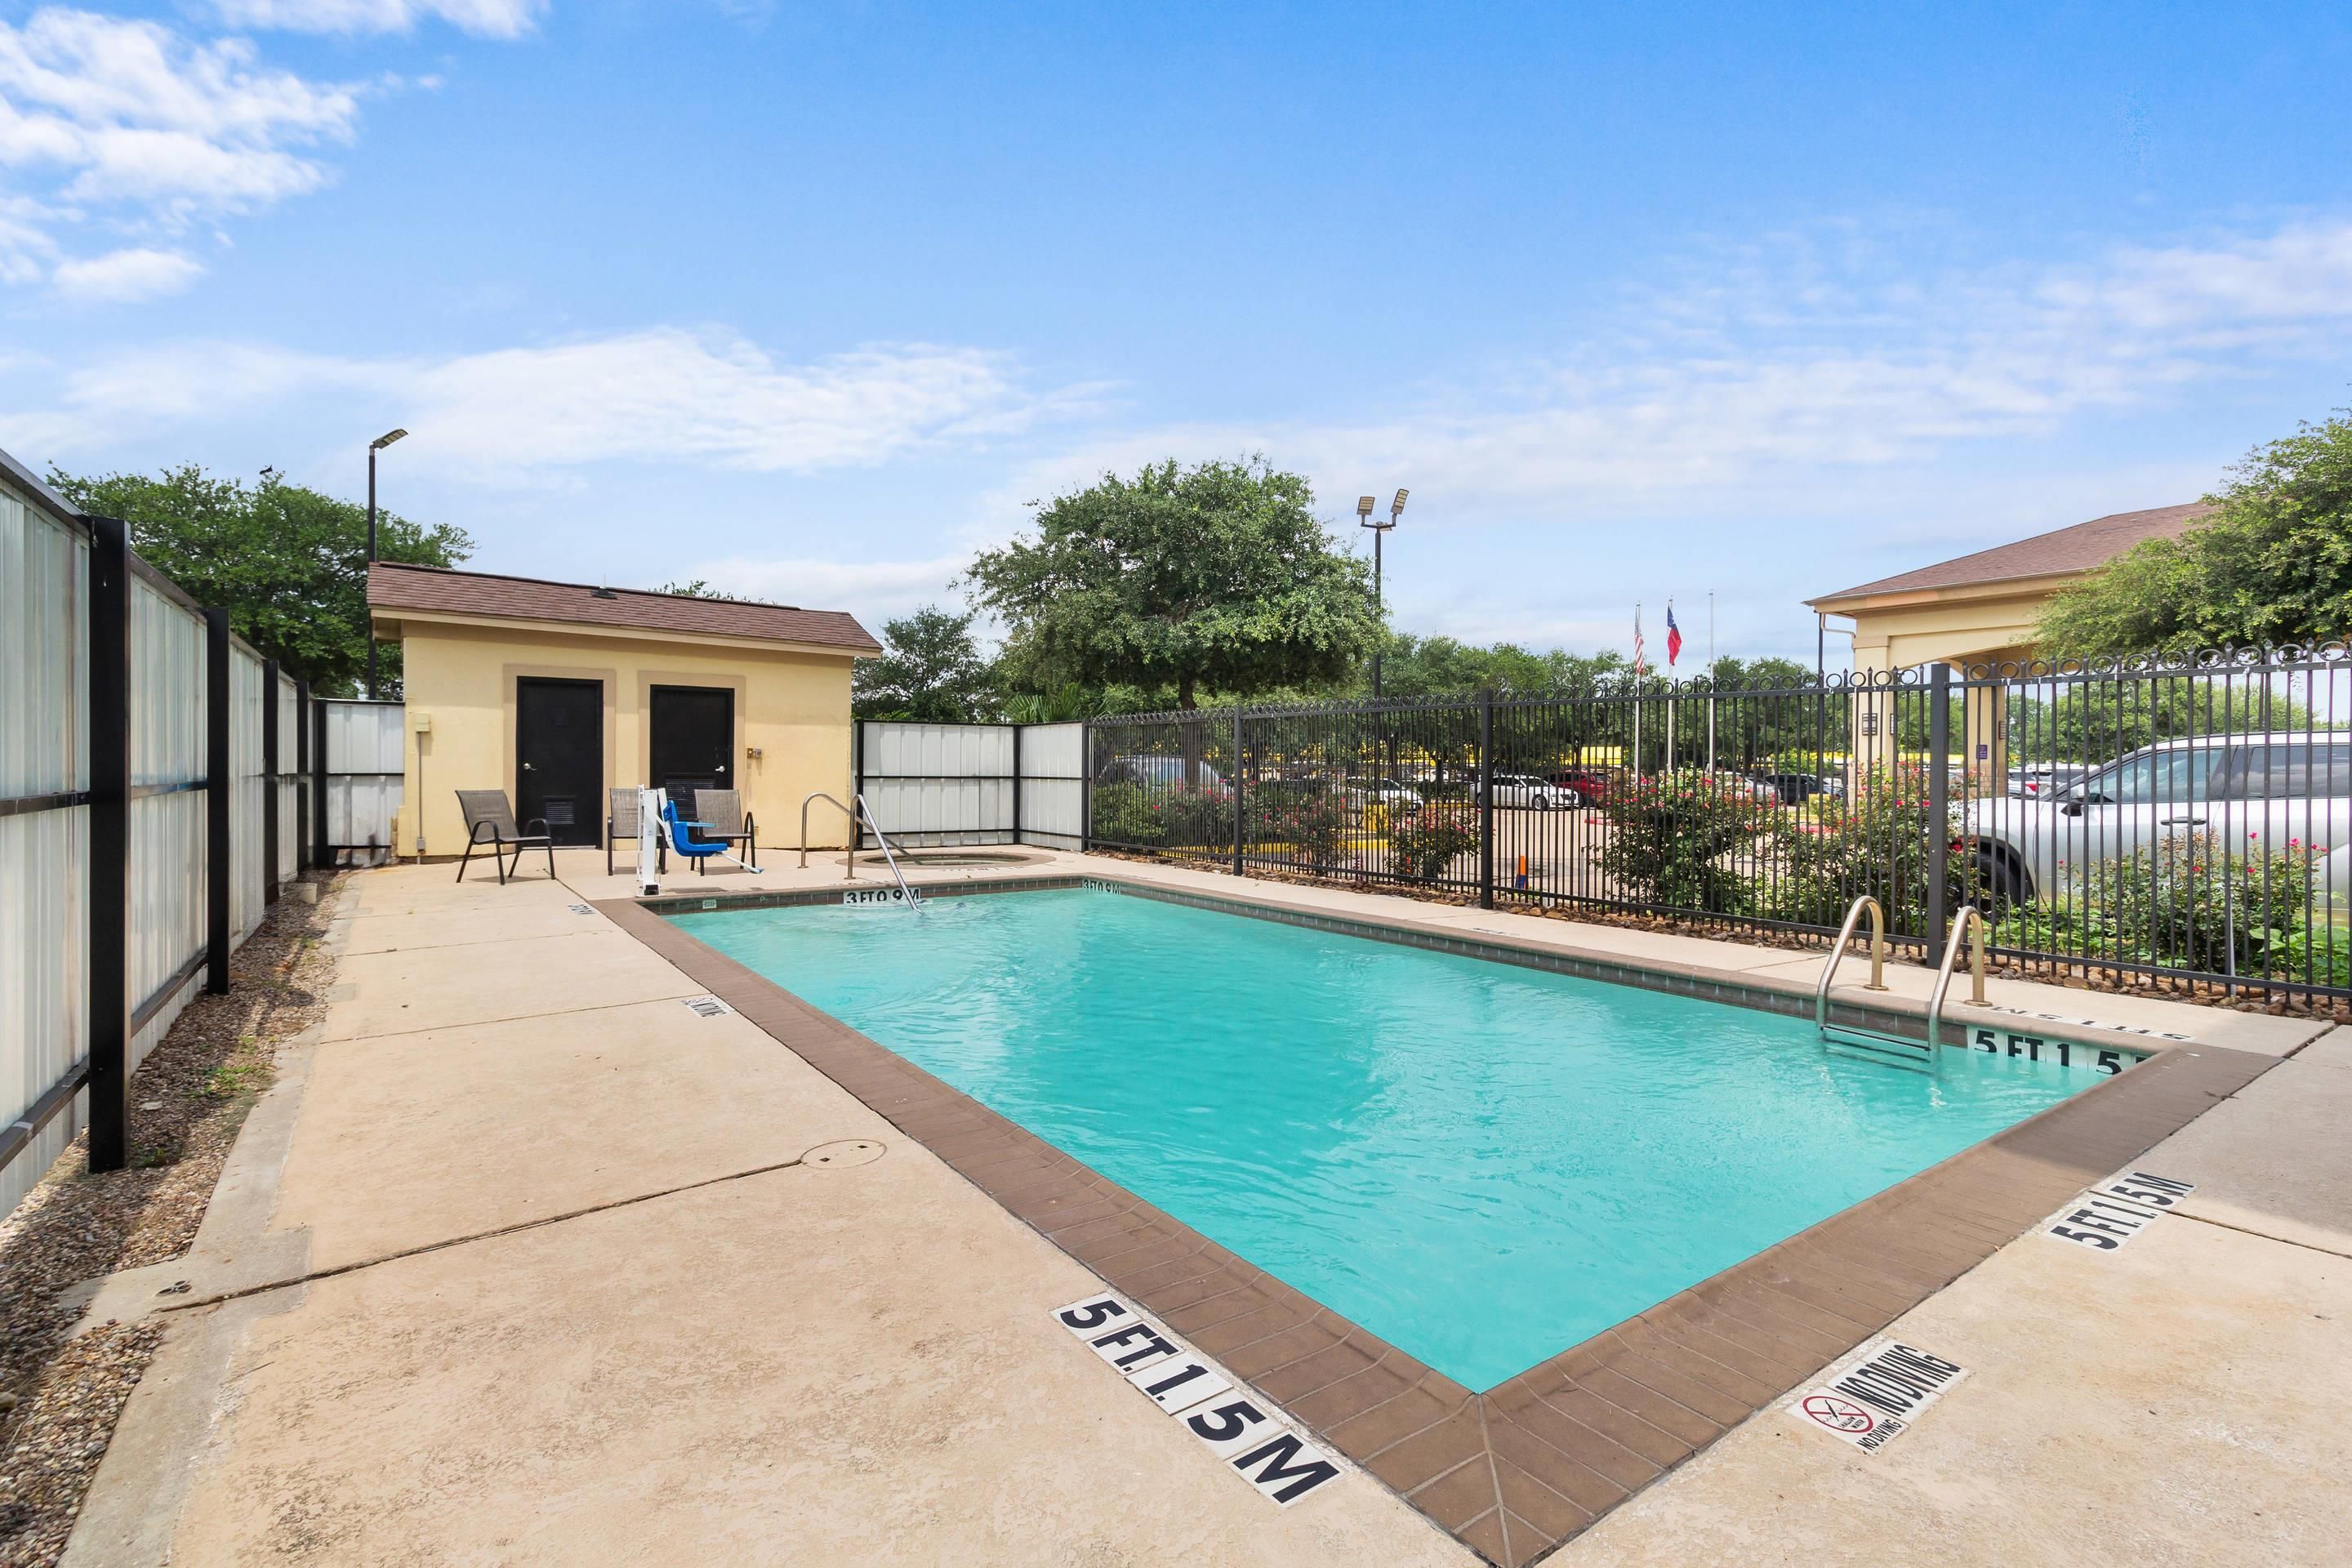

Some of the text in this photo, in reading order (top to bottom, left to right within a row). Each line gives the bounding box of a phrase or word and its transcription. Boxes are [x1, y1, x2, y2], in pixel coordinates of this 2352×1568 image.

[846, 892, 858, 903] 3
[860, 891, 875, 903] FT
[1975, 1030, 1997, 1054] 5
[2007, 1035, 2043, 1062] FT
[2050, 1226, 2118, 1250] 5
[2123, 1172, 2194, 1198] M
[1060, 1300, 1127, 1329] 5
[1232, 1433, 1340, 1503] M
[1836, 1344, 1962, 1416] NO DIVING
[1856, 1419, 1902, 1450] NO DIVING
